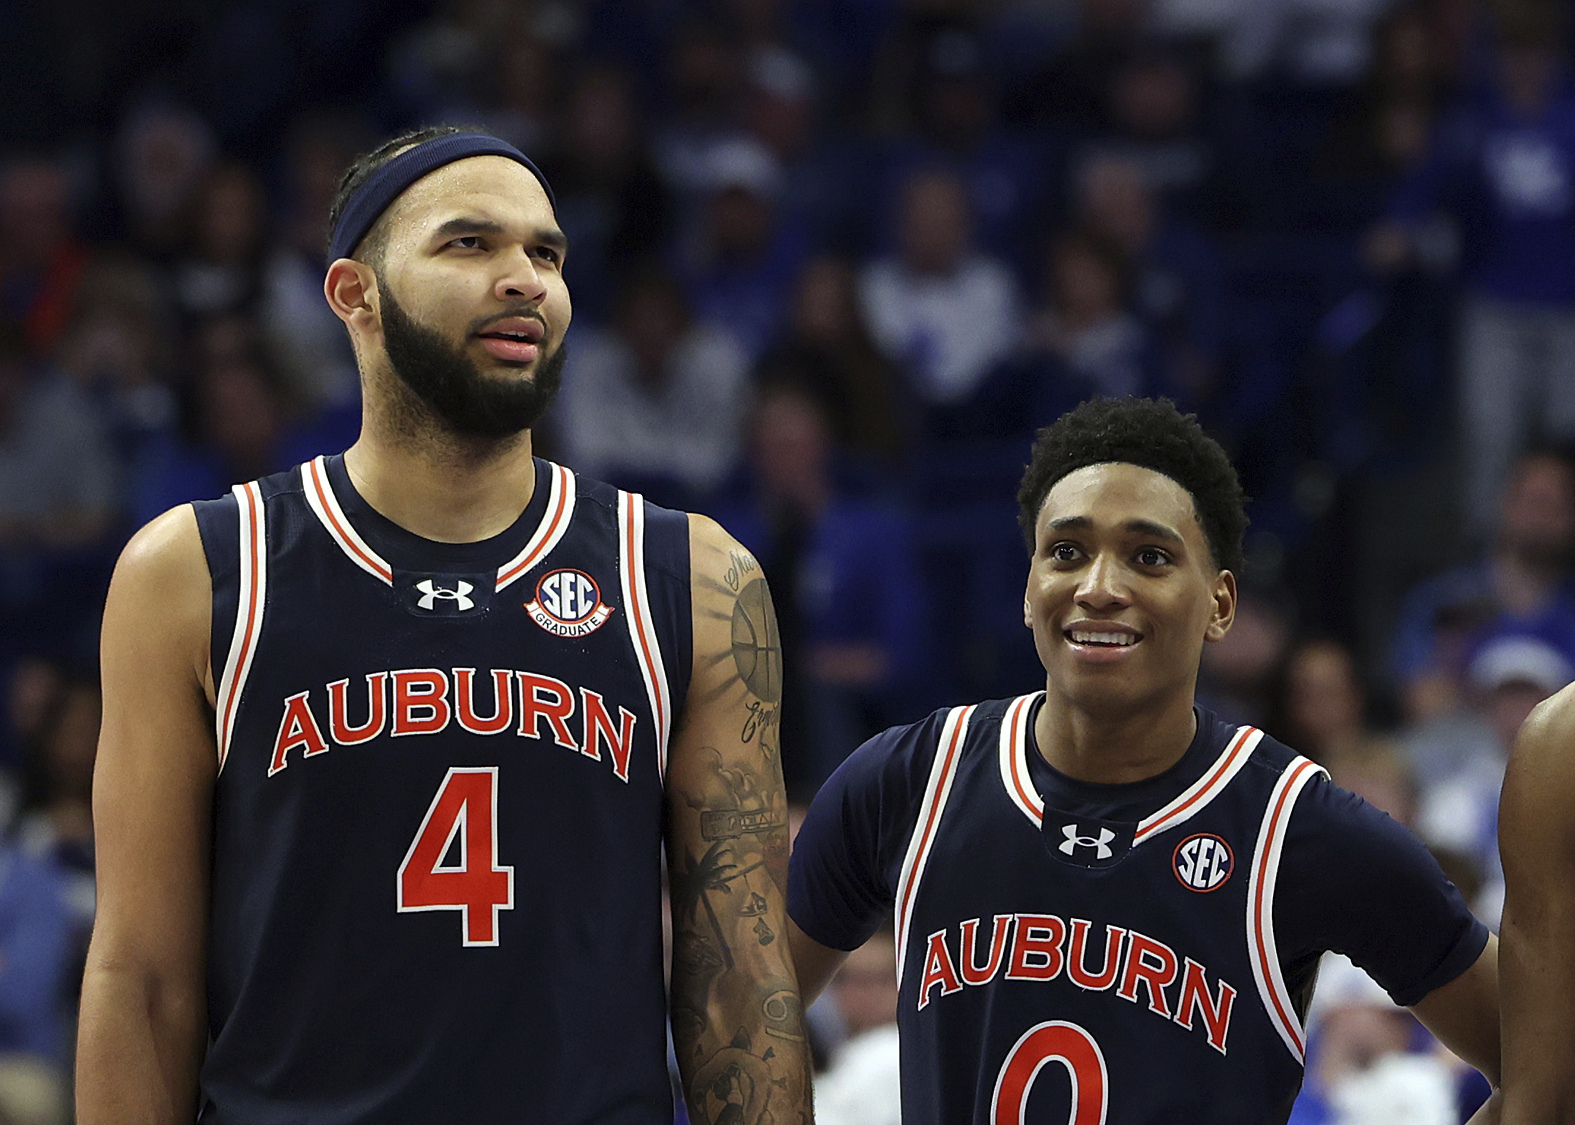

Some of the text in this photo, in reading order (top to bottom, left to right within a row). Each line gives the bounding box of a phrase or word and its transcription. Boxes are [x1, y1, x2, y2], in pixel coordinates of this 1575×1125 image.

[535, 613, 601, 636] GRADUATE
[541, 572, 594, 619] SEC
[267, 667, 637, 783] AUBURN
[397, 766, 514, 947] 4
[1178, 838, 1229, 888] SEC
[917, 913, 1237, 1056] AUBURN
